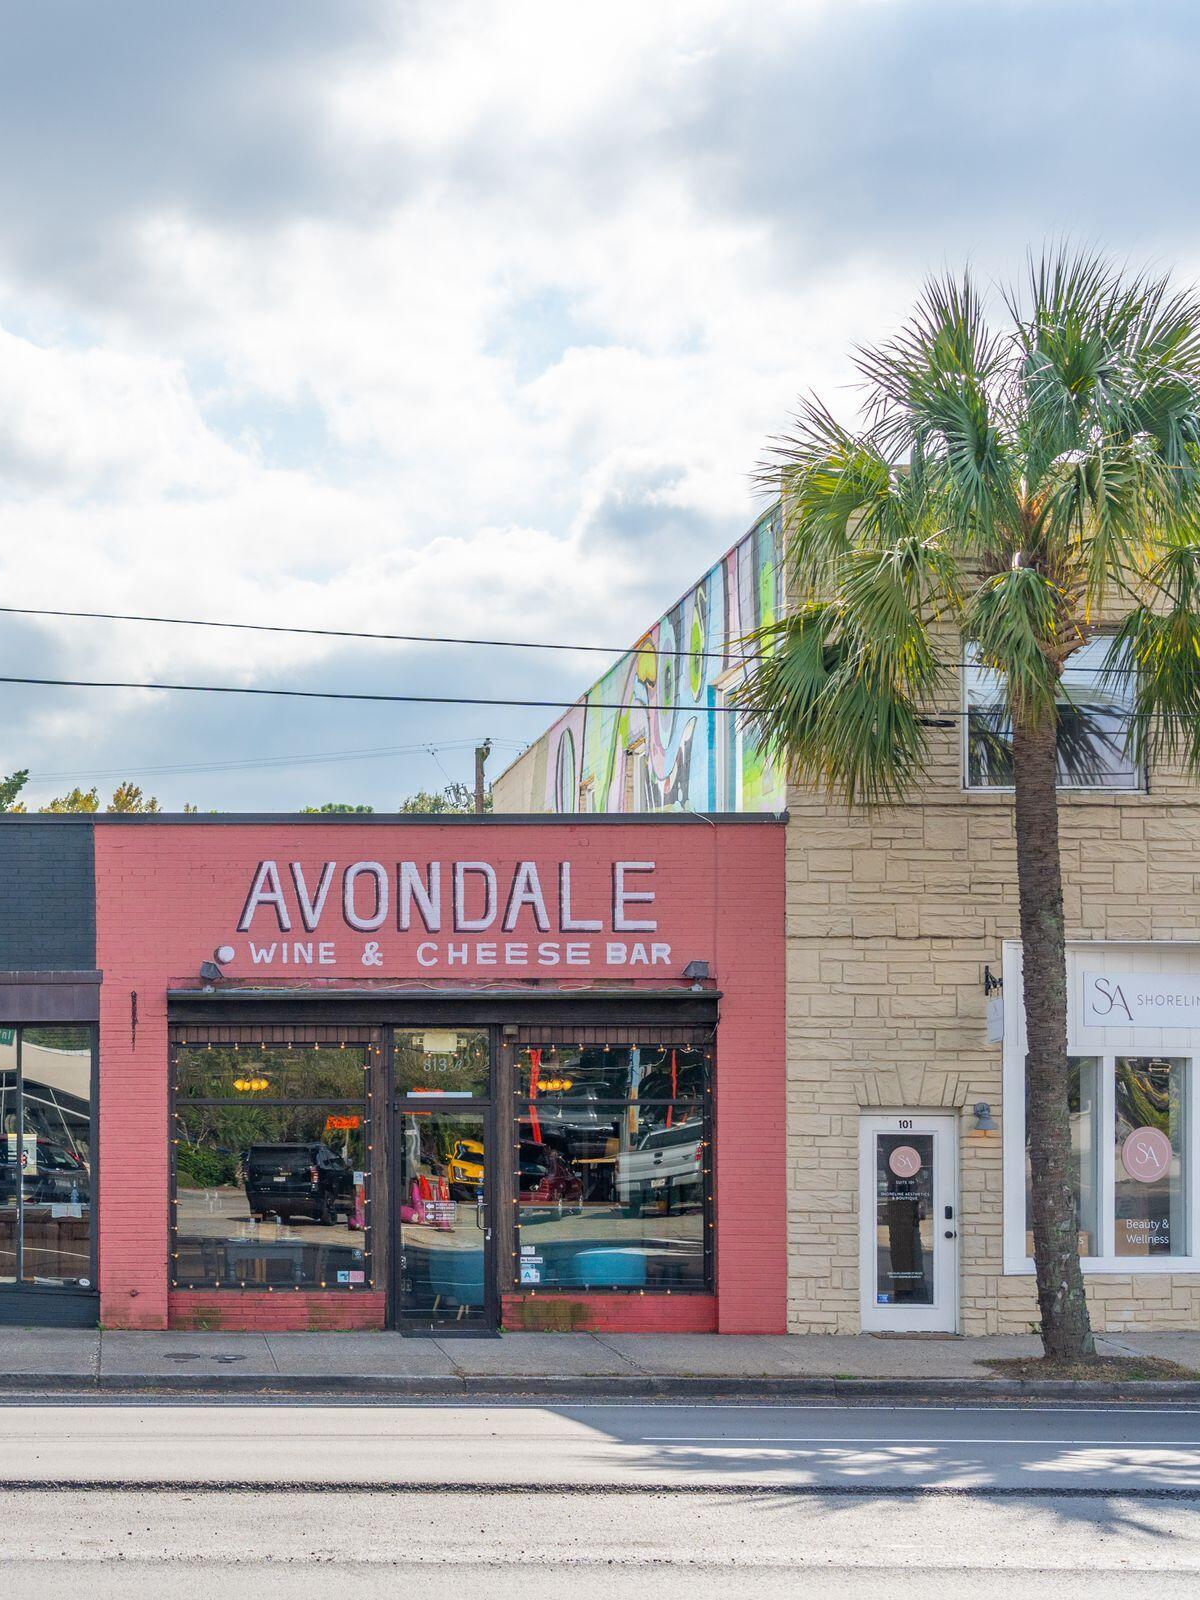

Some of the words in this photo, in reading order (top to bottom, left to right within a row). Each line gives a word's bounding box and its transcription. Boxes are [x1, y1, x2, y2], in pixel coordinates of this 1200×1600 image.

[236, 861, 658, 933] AVONDALE
[249, 941, 337, 964] WINE
[361, 940, 384, 966] &
[416, 941, 591, 966] CHEESE
[606, 942, 672, 965] BAR
[1137, 994, 1200, 1006] SHORELI
[423, 1058, 447, 1072] 813
[898, 1120, 913, 1129] 101
[1126, 1219, 1160, 1231] Beauty
[1162, 1219, 1170, 1229] &
[1126, 1234, 1169, 1244] Wellness
